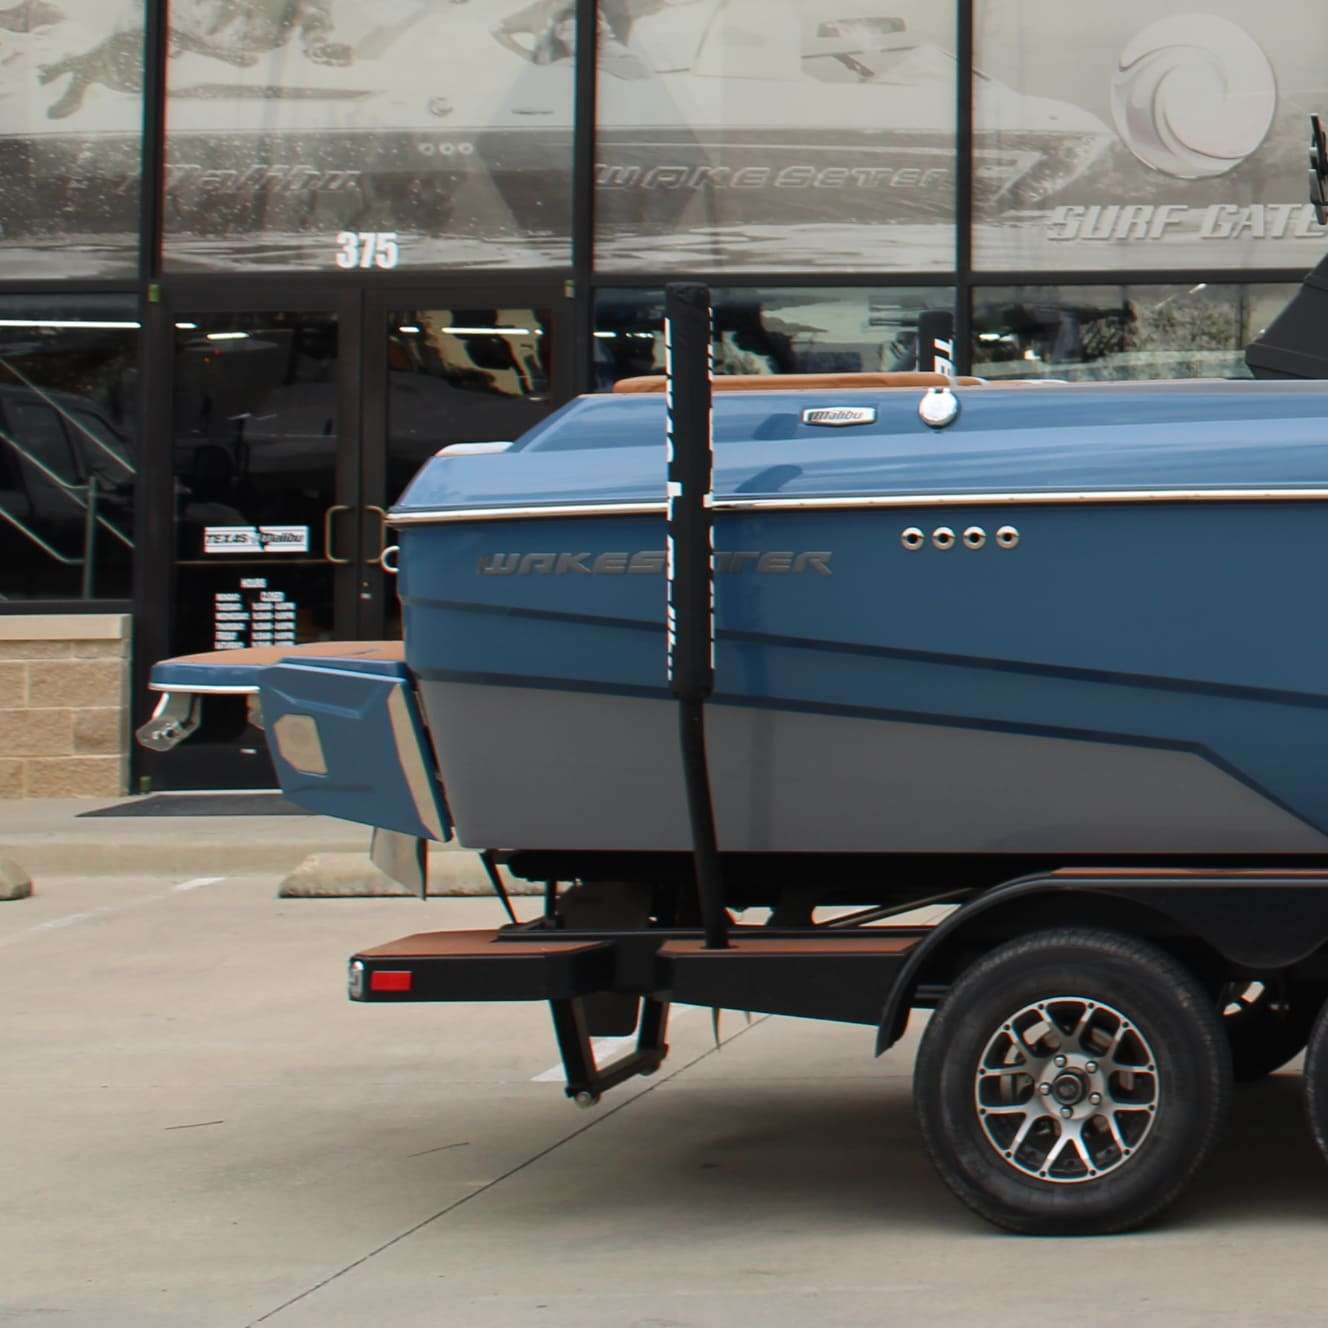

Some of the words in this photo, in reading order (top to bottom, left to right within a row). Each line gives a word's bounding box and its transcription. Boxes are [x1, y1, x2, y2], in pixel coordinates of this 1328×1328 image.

[1048, 204, 1189, 242] SURF
[1200, 203, 1328, 241] GATE
[335, 231, 399, 269] 375
[809, 410, 864, 422] Malibu
